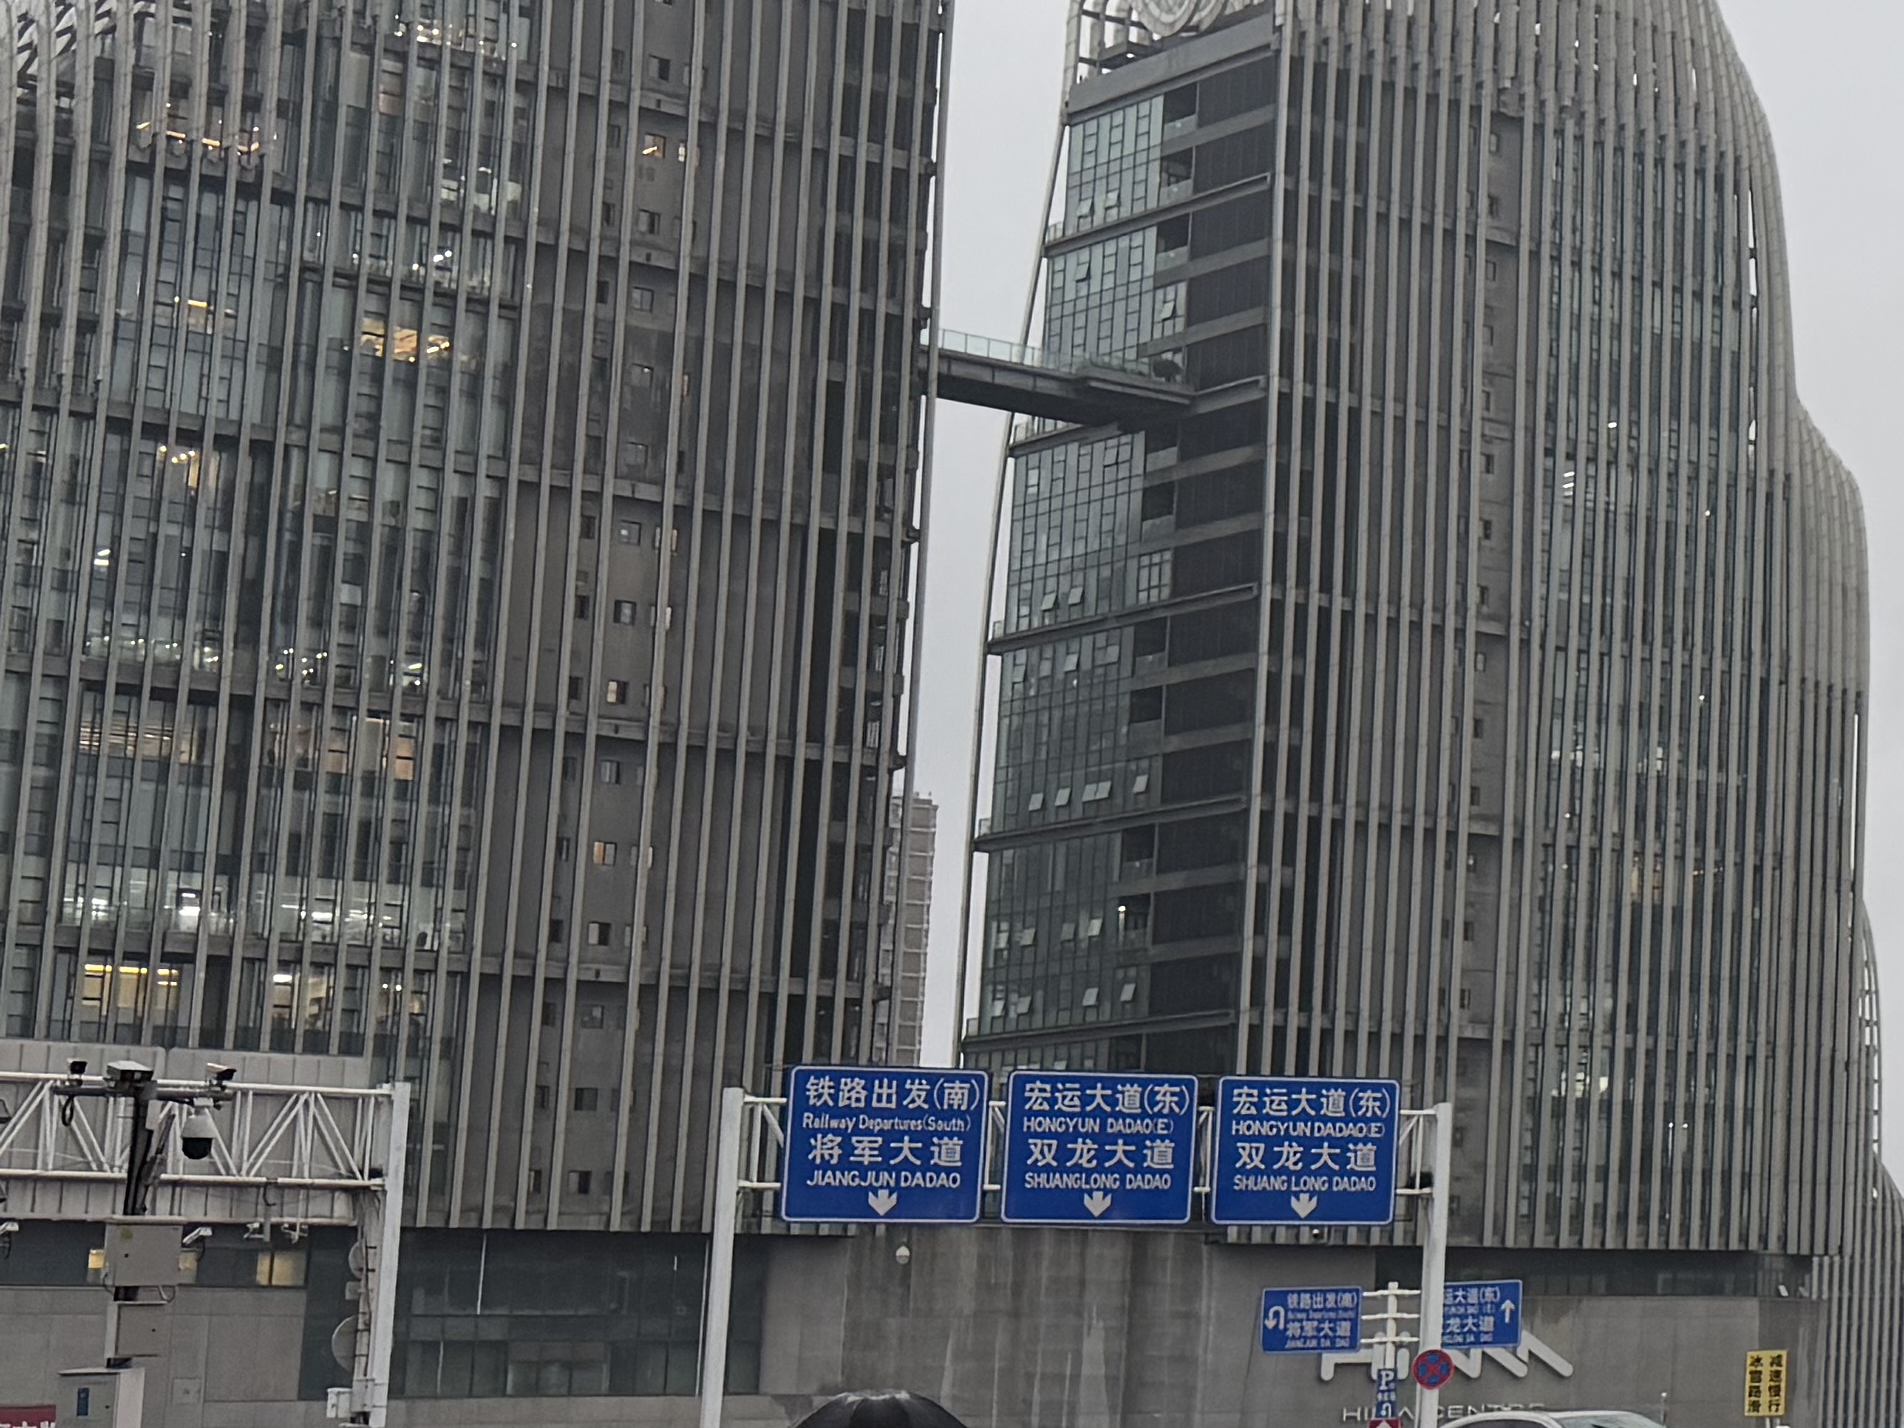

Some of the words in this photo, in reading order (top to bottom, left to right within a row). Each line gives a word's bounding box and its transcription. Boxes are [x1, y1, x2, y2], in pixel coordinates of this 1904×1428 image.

[806, 1075, 980, 1111] 铁路出发(南)
[1024, 1080, 1190, 1115] 宏运大道(东)
[1232, 1085, 1391, 1118] 宏运大道(东)
[803, 1112, 856, 1132] Railway
[1023, 1116, 1100, 1133] HONGYUN
[1232, 1120, 1311, 1136] HONGYUN
[808, 1133, 963, 1167] 将军大道
[1026, 1138, 1175, 1169] 双龙大道
[1235, 1141, 1377, 1171] 双龙大道
[807, 1169, 895, 1188] JIANGJUN
[901, 1172, 961, 1188] DADAO
[1024, 1172, 1120, 1189] SHUANGLONG
[1126, 1173, 1171, 1189] DADAO
[1332, 1177, 1376, 1192] DADAO
